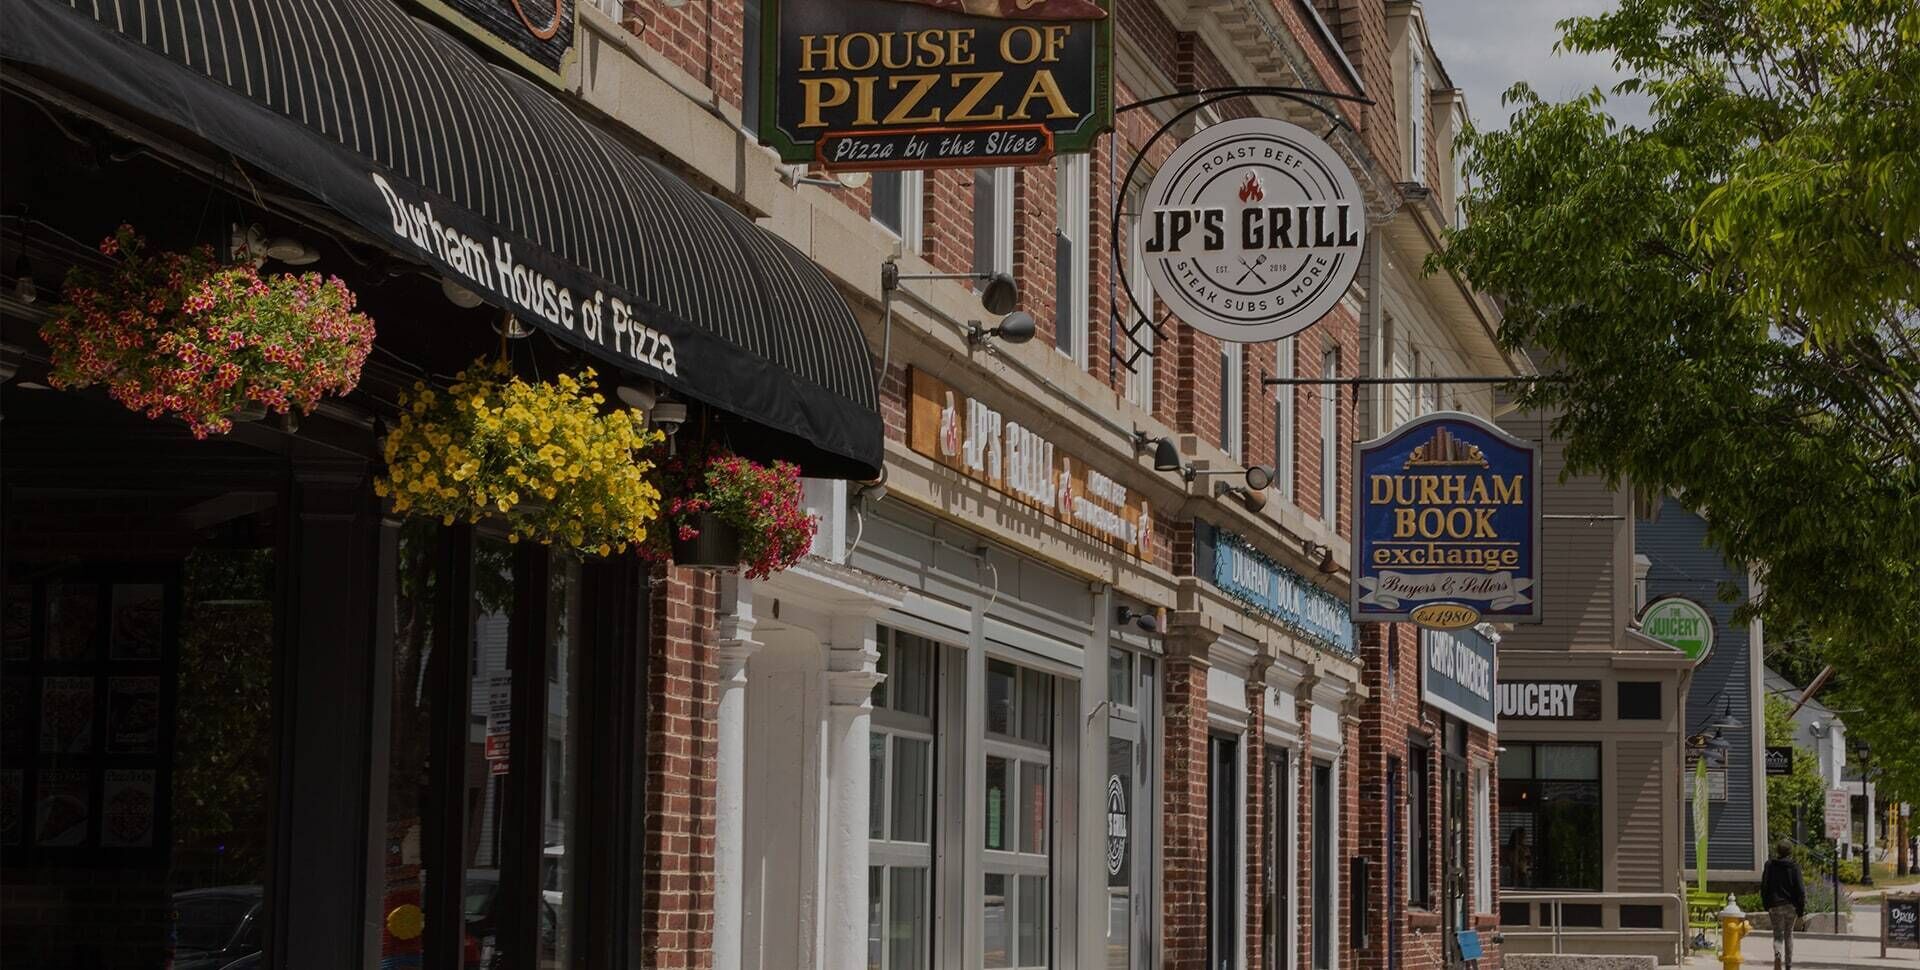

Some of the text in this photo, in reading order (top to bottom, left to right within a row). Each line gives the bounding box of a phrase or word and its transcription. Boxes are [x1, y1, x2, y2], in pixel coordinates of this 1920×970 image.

[798, 24, 1072, 72] HOUSE OF
[797, 69, 1080, 129] PIZZA
[834, 131, 1039, 162] Pizza by the Slice
[1202, 147, 1304, 174] ROAST BEEF
[1145, 205, 1358, 252] JP'S GRILL
[372, 171, 679, 378] Durham House of Pizza
[1177, 256, 1328, 312] STEAK SUBS & MORE
[962, 397, 1002, 480] JP'S
[1005, 421, 1056, 508] GRILL
[1370, 474, 1524, 505] DURHAM
[1393, 507, 1498, 539] BOOK
[1372, 544, 1519, 571] exchange
[1382, 575, 1508, 599] Buyers & Sellers
[1435, 610, 1472, 625] 1980
[1649, 618, 1700, 636] JUICERY
[1496, 683, 1578, 717] JUICERY
